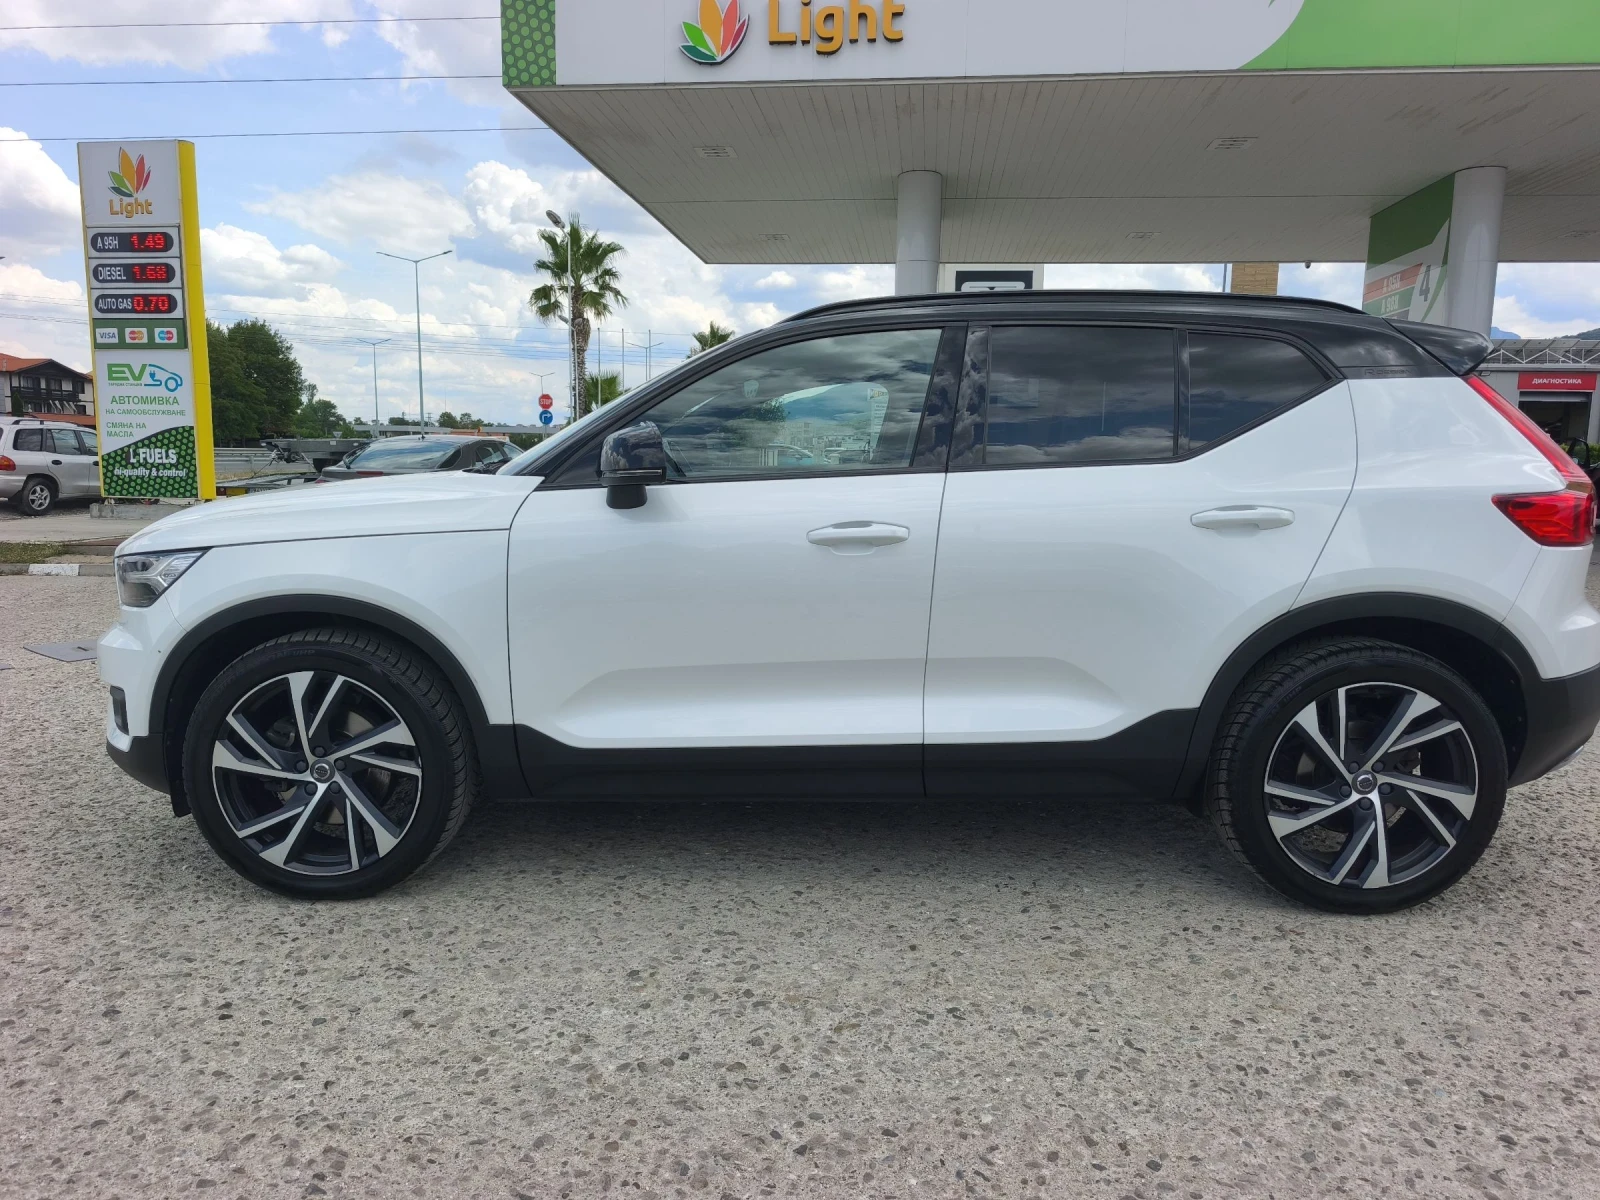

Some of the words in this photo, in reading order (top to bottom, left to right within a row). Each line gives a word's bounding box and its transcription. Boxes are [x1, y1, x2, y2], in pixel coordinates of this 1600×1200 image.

[768, 0, 905, 56] Light
[109, 198, 153, 218] Light
[103, 236, 119, 249] 95H
[130, 234, 165, 248] 1.49
[98, 267, 126, 280] DIESEL
[1419, 264, 1432, 302] 4
[98, 298, 117, 309] AUTO
[117, 298, 132, 309] GAS
[133, 296, 169, 311] 0.70
[107, 363, 148, 381] EV
[110, 395, 180, 406] АВТОМИВКА
[116, 408, 186, 416] САМООБСЛУЖВАНЕ
[139, 448, 178, 464] FUELS
[114, 467, 150, 477] hi-quality
[151, 467, 158, 476] &
[158, 468, 187, 477] control
